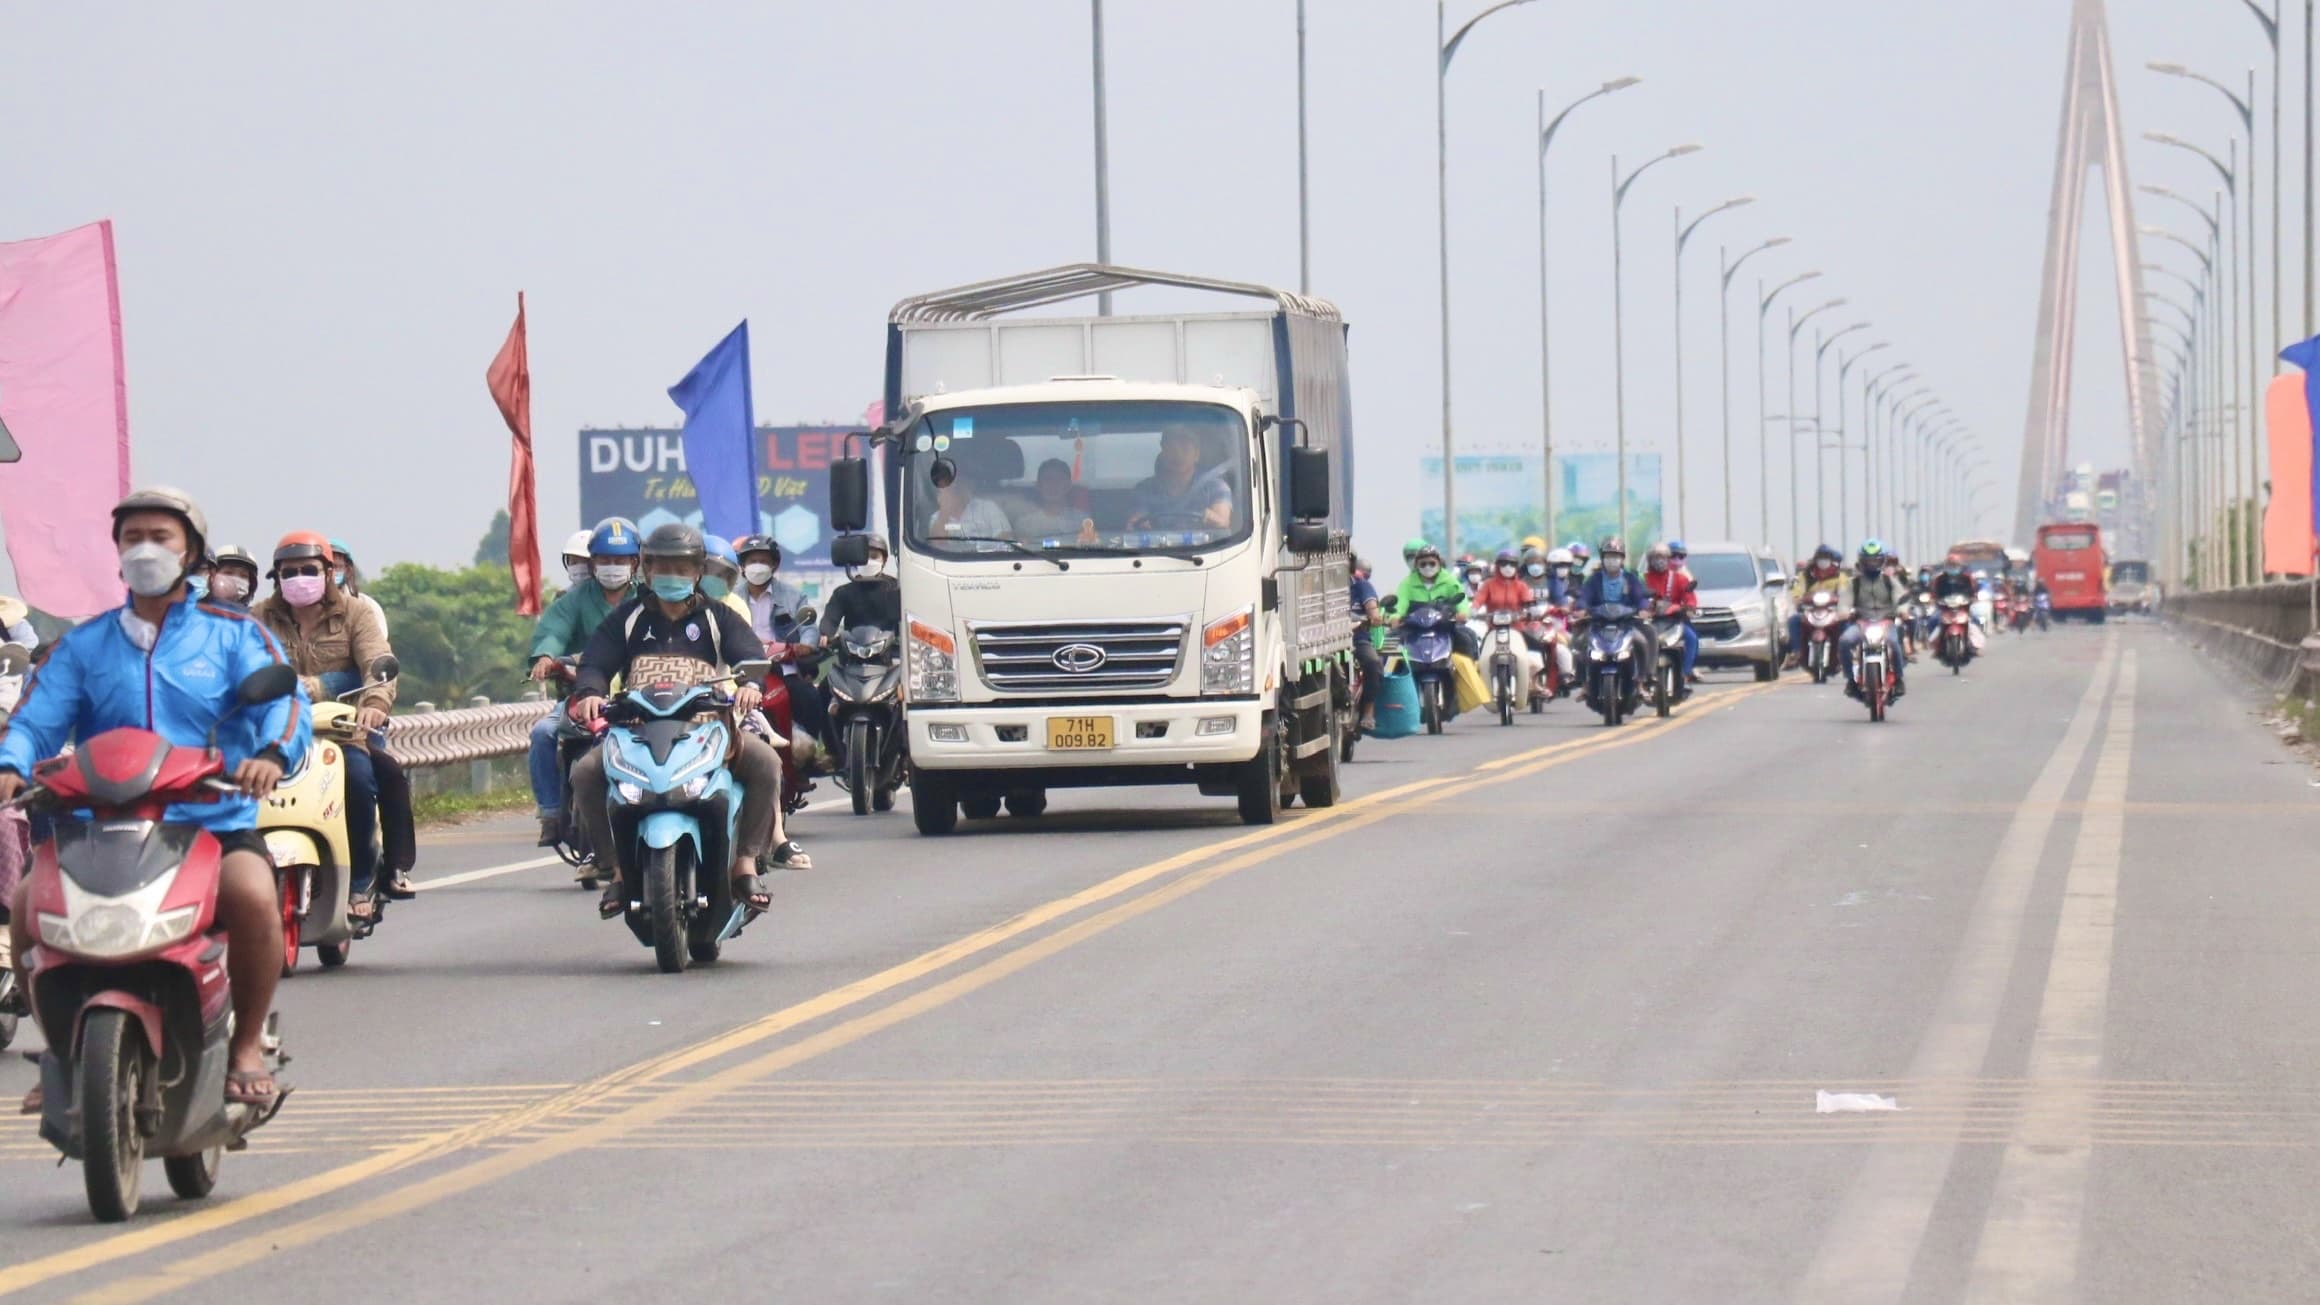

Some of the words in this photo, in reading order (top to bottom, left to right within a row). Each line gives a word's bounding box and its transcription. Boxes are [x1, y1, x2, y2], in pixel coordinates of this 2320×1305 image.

[590, 436, 687, 473] DUH
[768, 432, 860, 470] LED
[1066, 718, 1095, 733] 71H
[1055, 733, 1107, 748] 009.82
